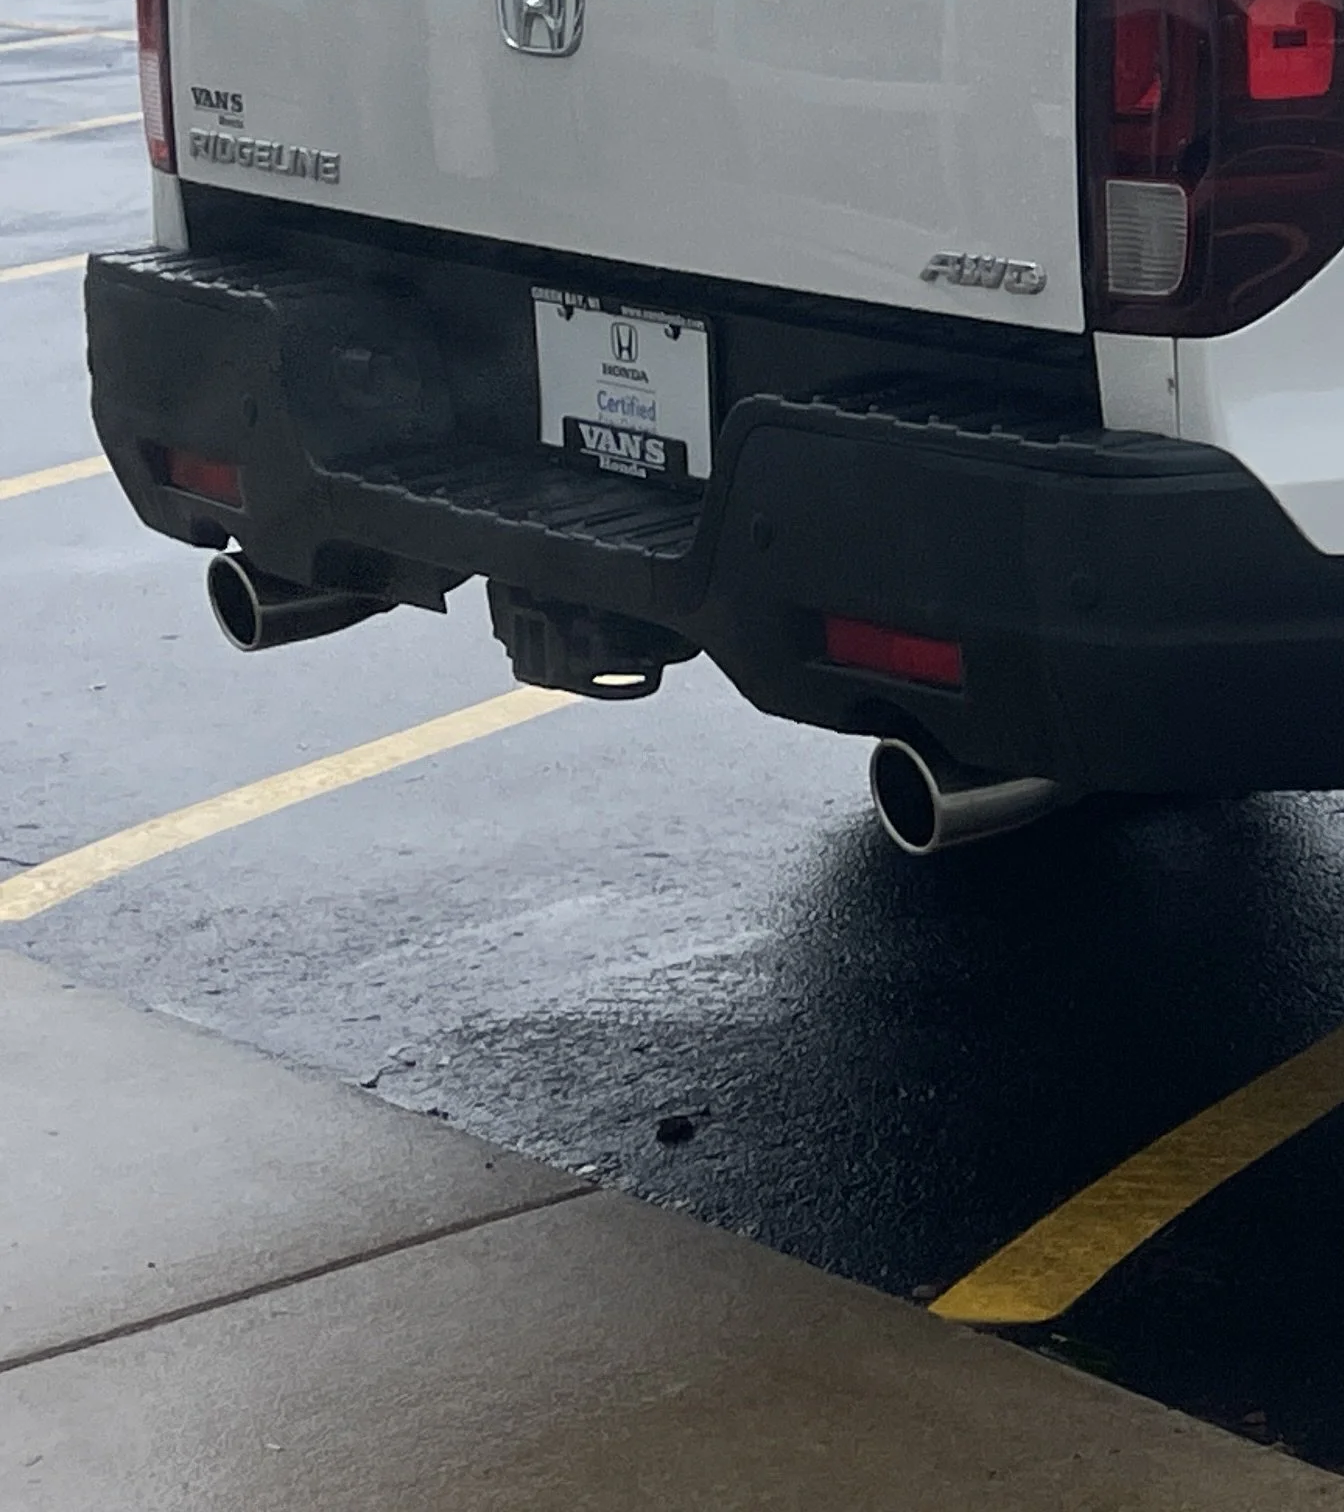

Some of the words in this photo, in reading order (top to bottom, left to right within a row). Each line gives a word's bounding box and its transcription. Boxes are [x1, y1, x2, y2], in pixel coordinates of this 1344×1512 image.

[189, 127, 342, 185] RIDGELINE
[919, 250, 1048, 295] AWD
[601, 362, 650, 384] HONDA
[596, 390, 657, 422] Certified
